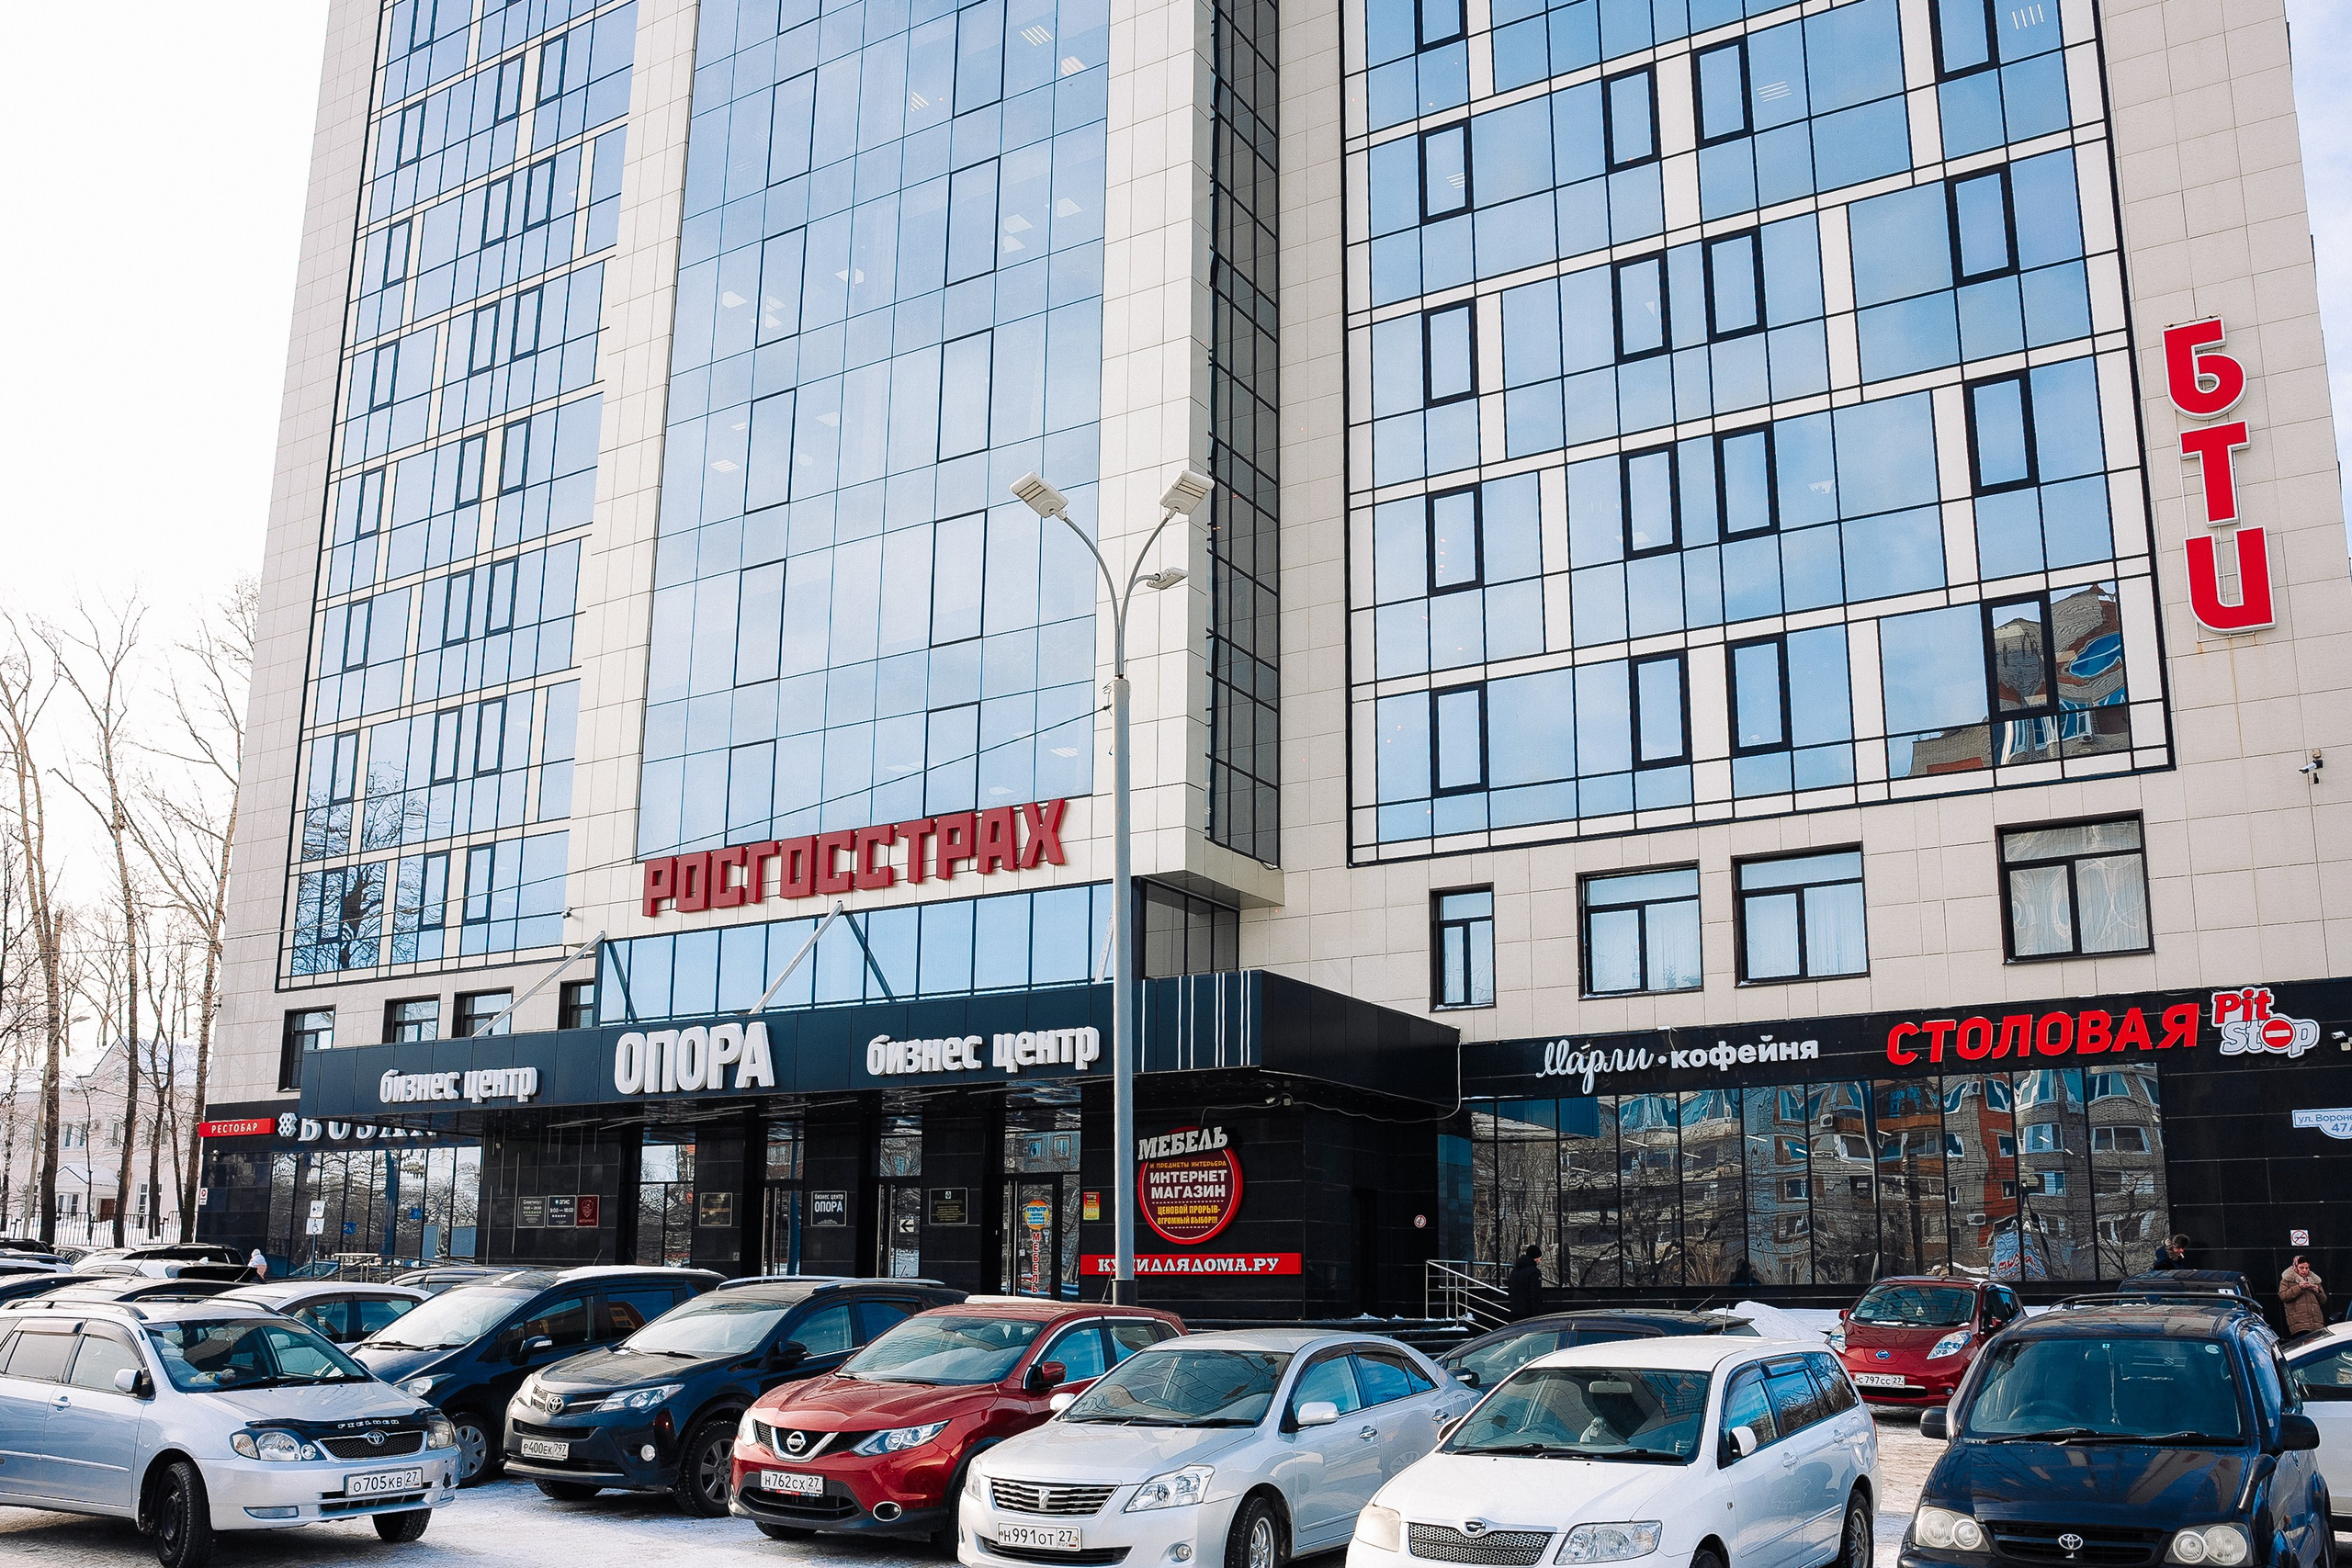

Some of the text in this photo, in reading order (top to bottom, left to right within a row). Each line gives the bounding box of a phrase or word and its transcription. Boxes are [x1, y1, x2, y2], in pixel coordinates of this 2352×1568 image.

[2162, 314, 2277, 634] БТИ
[642, 798, 1066, 917] РОСГОССТРАХ
[2212, 987, 2274, 1026] Pit
[1886, 1003, 2200, 1066] СТОЛОВАЯ
[614, 1021, 775, 1094] ОПОРА
[866, 1026, 1100, 1076] бизнес центр
[1671, 1035, 1819, 1071] кофейня
[379, 1066, 537, 1103] бизнес центр
[211, 1123, 258, 1134] РЕСТОБАР
[2298, 1115, 2313, 1123] ул.
[1138, 1126, 1228, 1160] МЕБЕЛЬ
[1149, 1169, 1227, 1184] ИНТЕРНЕТ
[1151, 1185, 1226, 1199] МАГАЗИН
[814, 1201, 843, 1213] ОПОРА
[1158, 1204, 1188, 1215] ЦЕНОВОЙ
[1158, 1216, 1190, 1224] ОГРОМНЫЙ
[1031, 1231, 1041, 1293] МЕБЕЛЬ
[406, 1472, 417, 1483] 27
[808, 1477, 820, 1488] 27
[1058, 1530, 1072, 1542] 27
